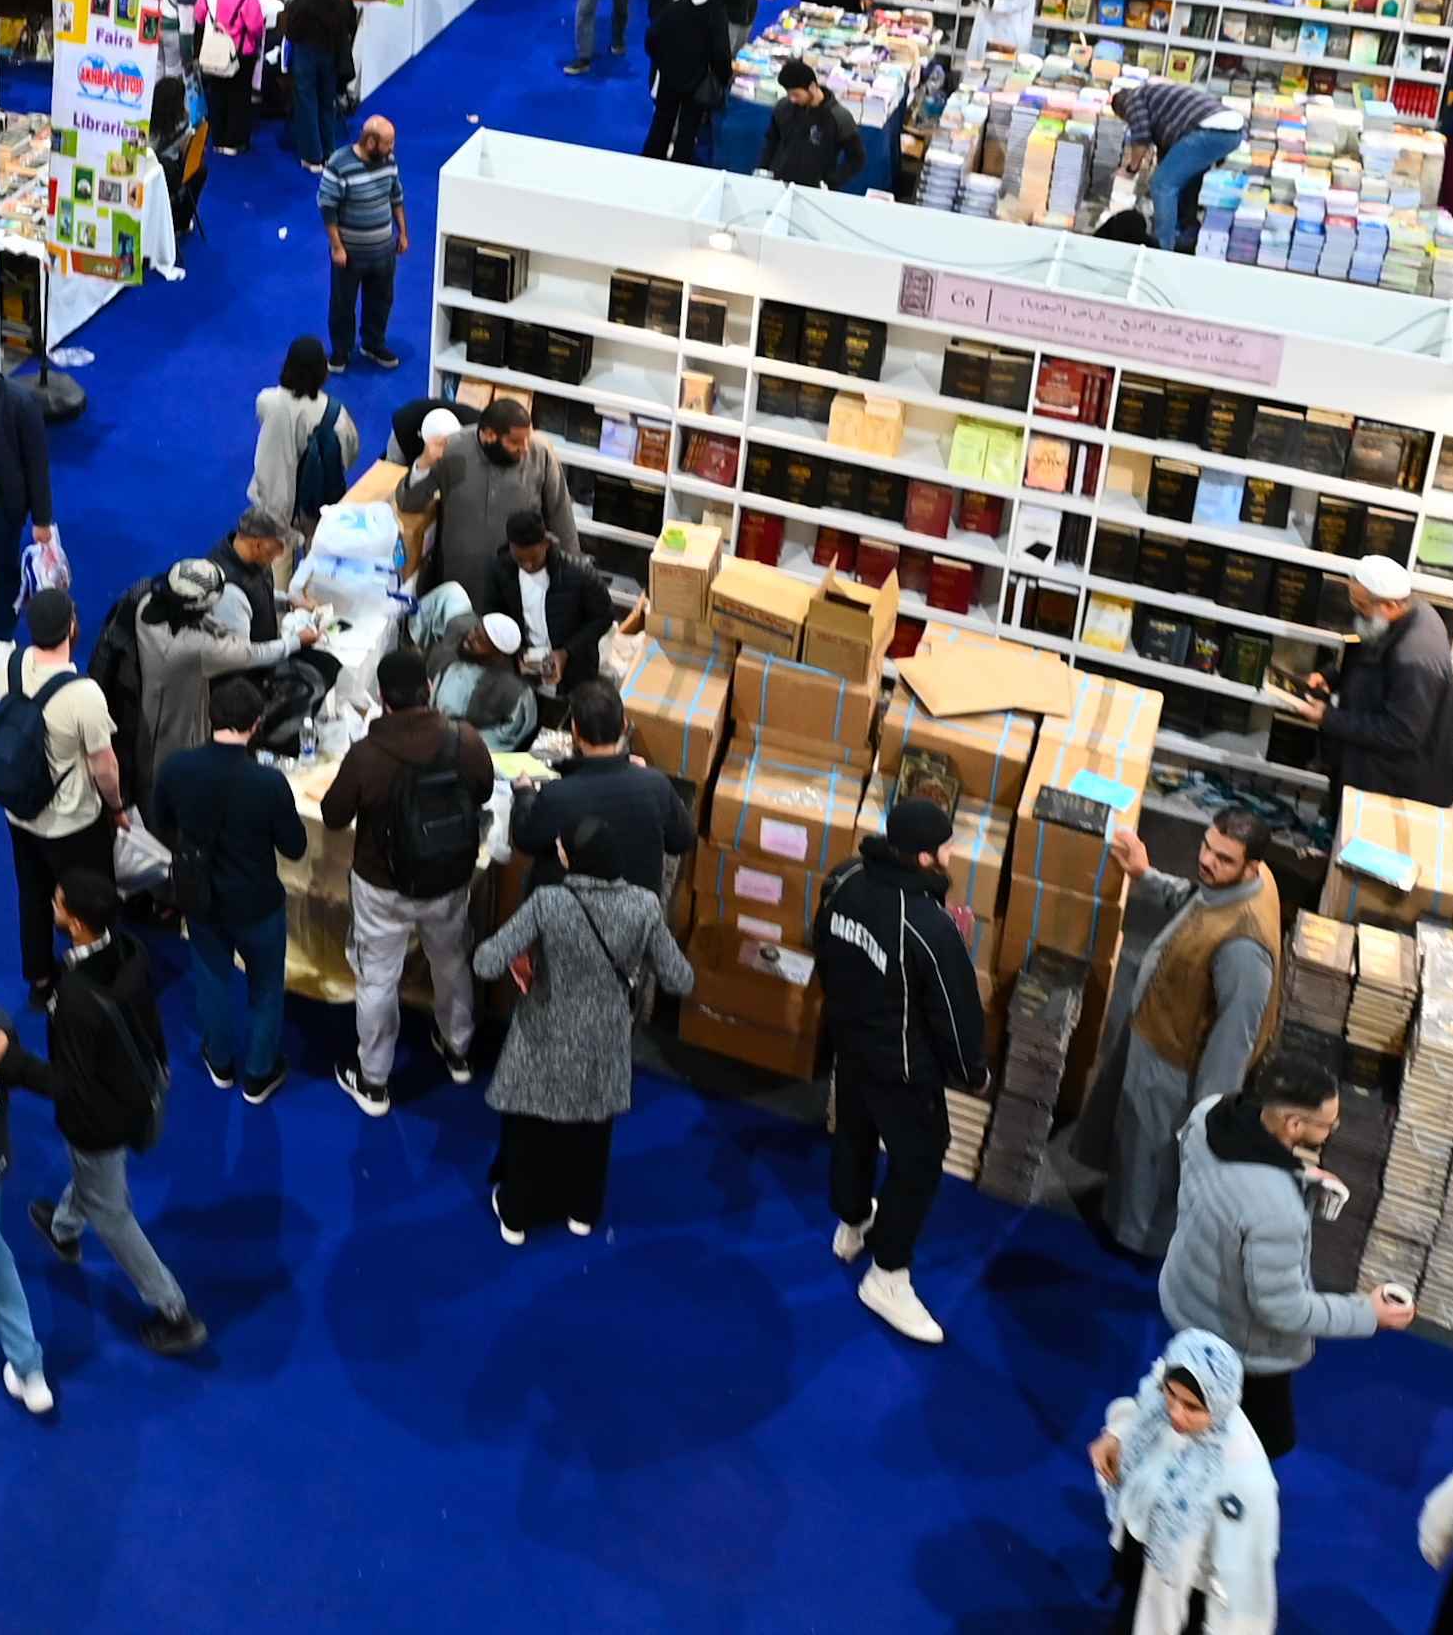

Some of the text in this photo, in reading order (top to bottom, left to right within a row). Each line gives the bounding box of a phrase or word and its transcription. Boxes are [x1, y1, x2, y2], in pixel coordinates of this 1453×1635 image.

[95, 27, 133, 49] Fairs
[73, 110, 147, 141] Libraries
[950, 289, 976, 309] C6
[830, 910, 888, 977] DAGESTAN
